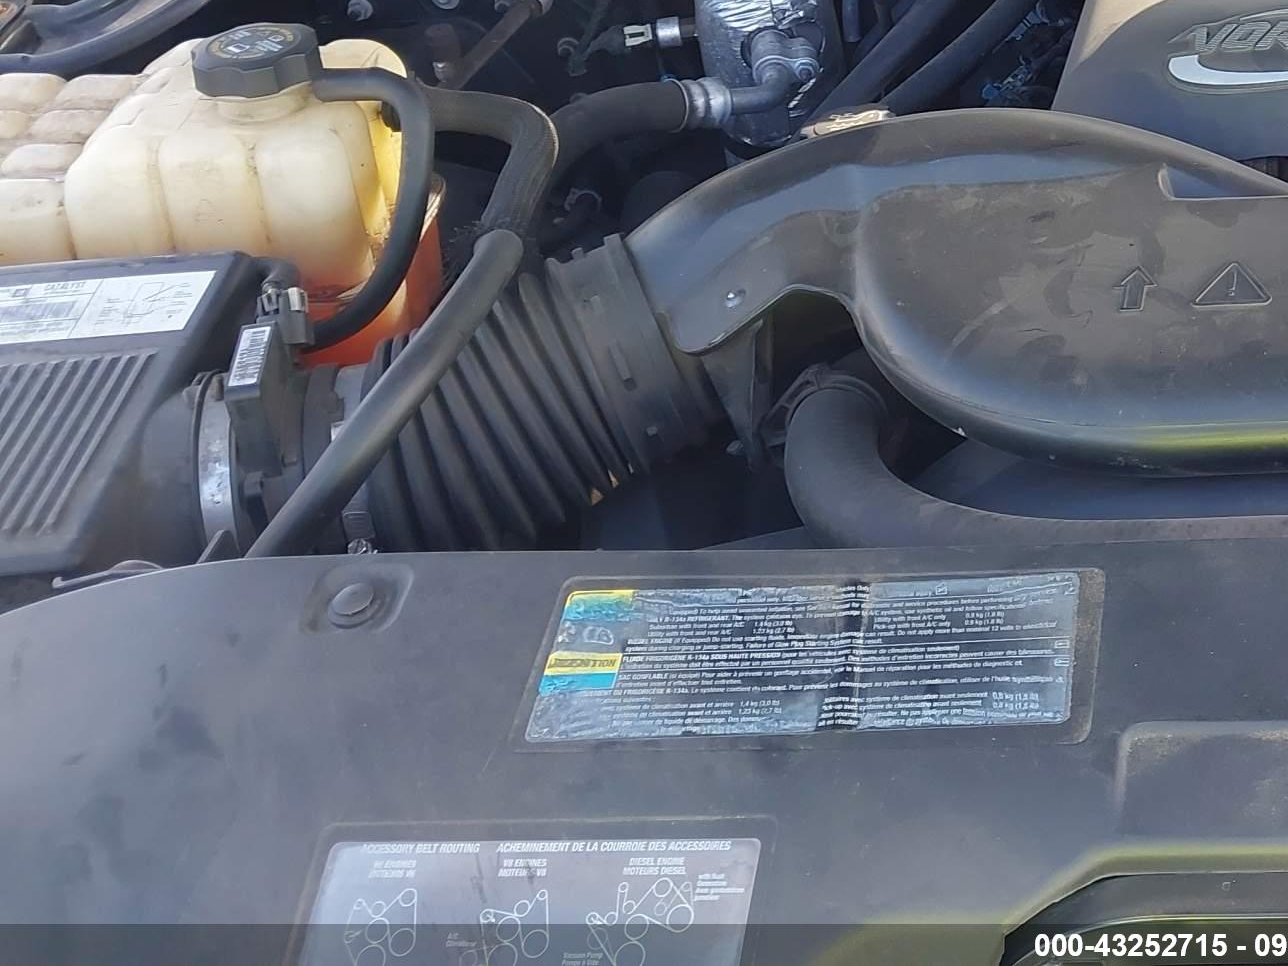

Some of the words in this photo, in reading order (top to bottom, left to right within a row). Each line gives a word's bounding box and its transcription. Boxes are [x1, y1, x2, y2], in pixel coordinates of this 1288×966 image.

[416, 843, 439, 854] BELT
[439, 843, 480, 854] ROUTING
[496, 842, 571, 853] ACHEMINEMENT
[571, 842, 585, 852] DE
[585, 841, 601, 852] LA
[601, 841, 647, 852] COURROIE
[647, 841, 667, 851] DES
[667, 841, 731, 851] ACCESSOIRES
